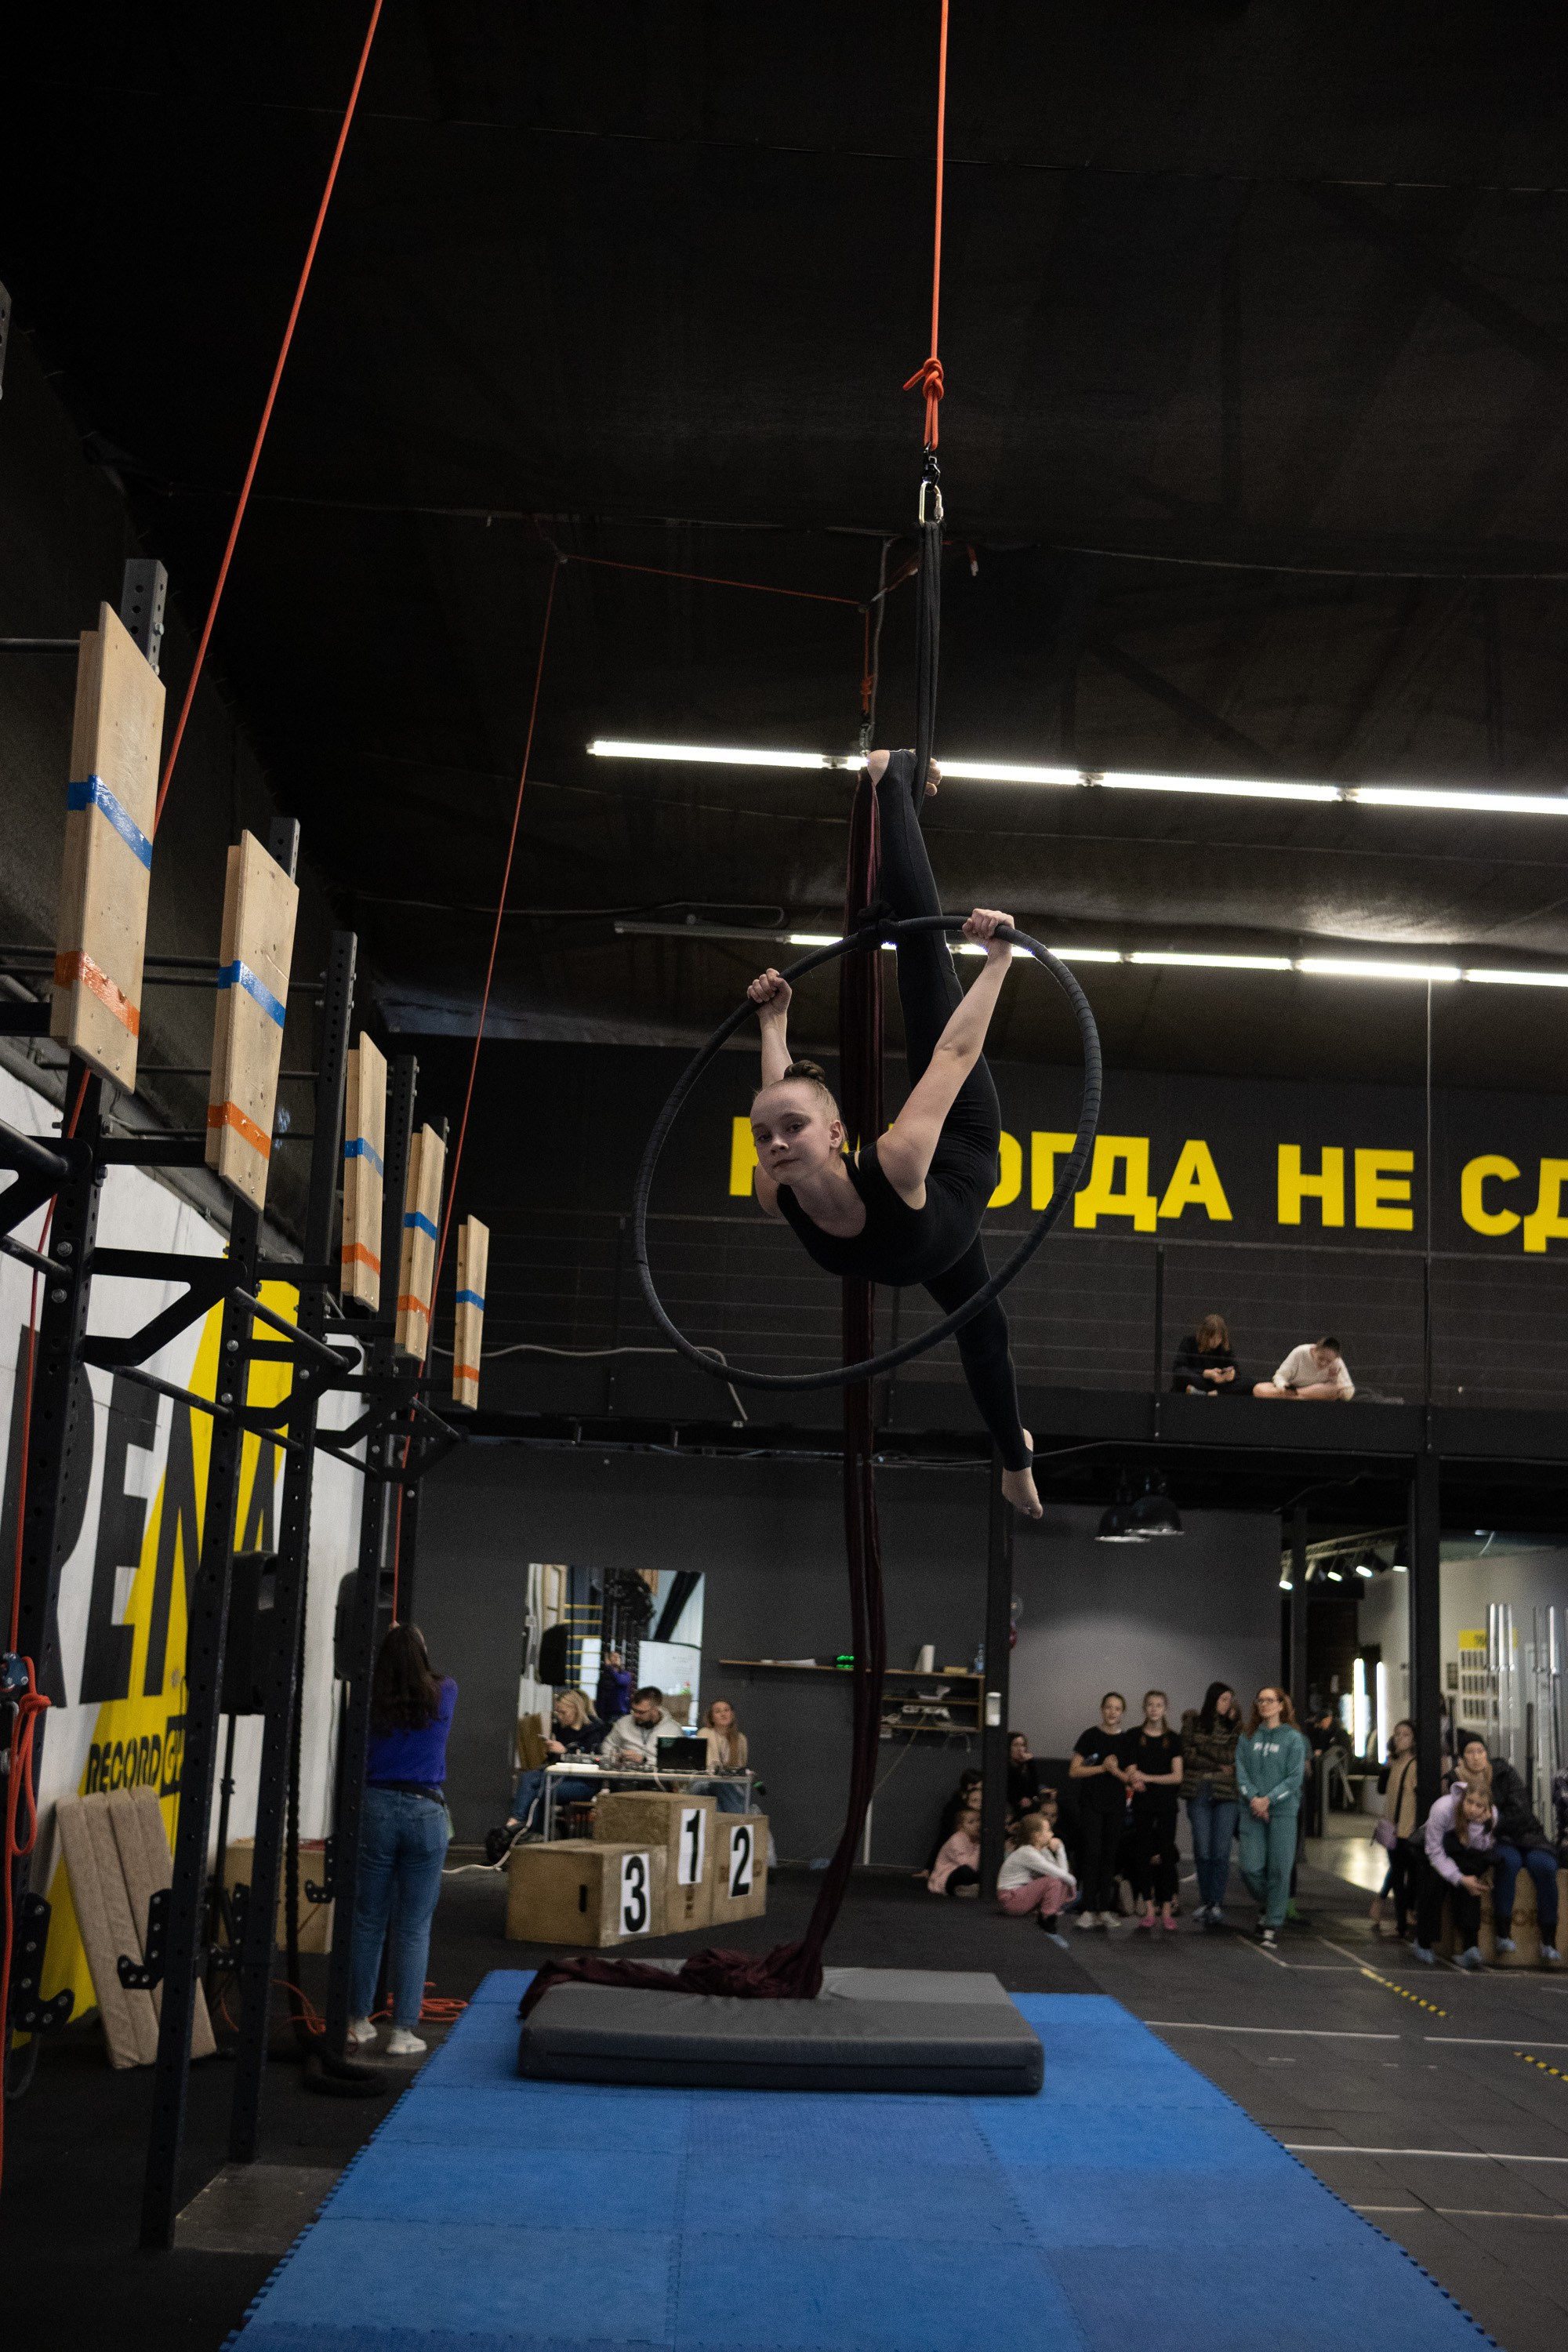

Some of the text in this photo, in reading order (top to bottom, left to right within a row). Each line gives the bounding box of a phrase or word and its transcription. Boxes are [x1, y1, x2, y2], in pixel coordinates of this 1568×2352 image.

[1278, 1144, 1414, 1231] НЕ
[85, 1735, 162, 1795] RECORD
[686, 1809, 700, 1882] 1
[731, 1827, 750, 1897] 2
[625, 1856, 646, 1933] 3
